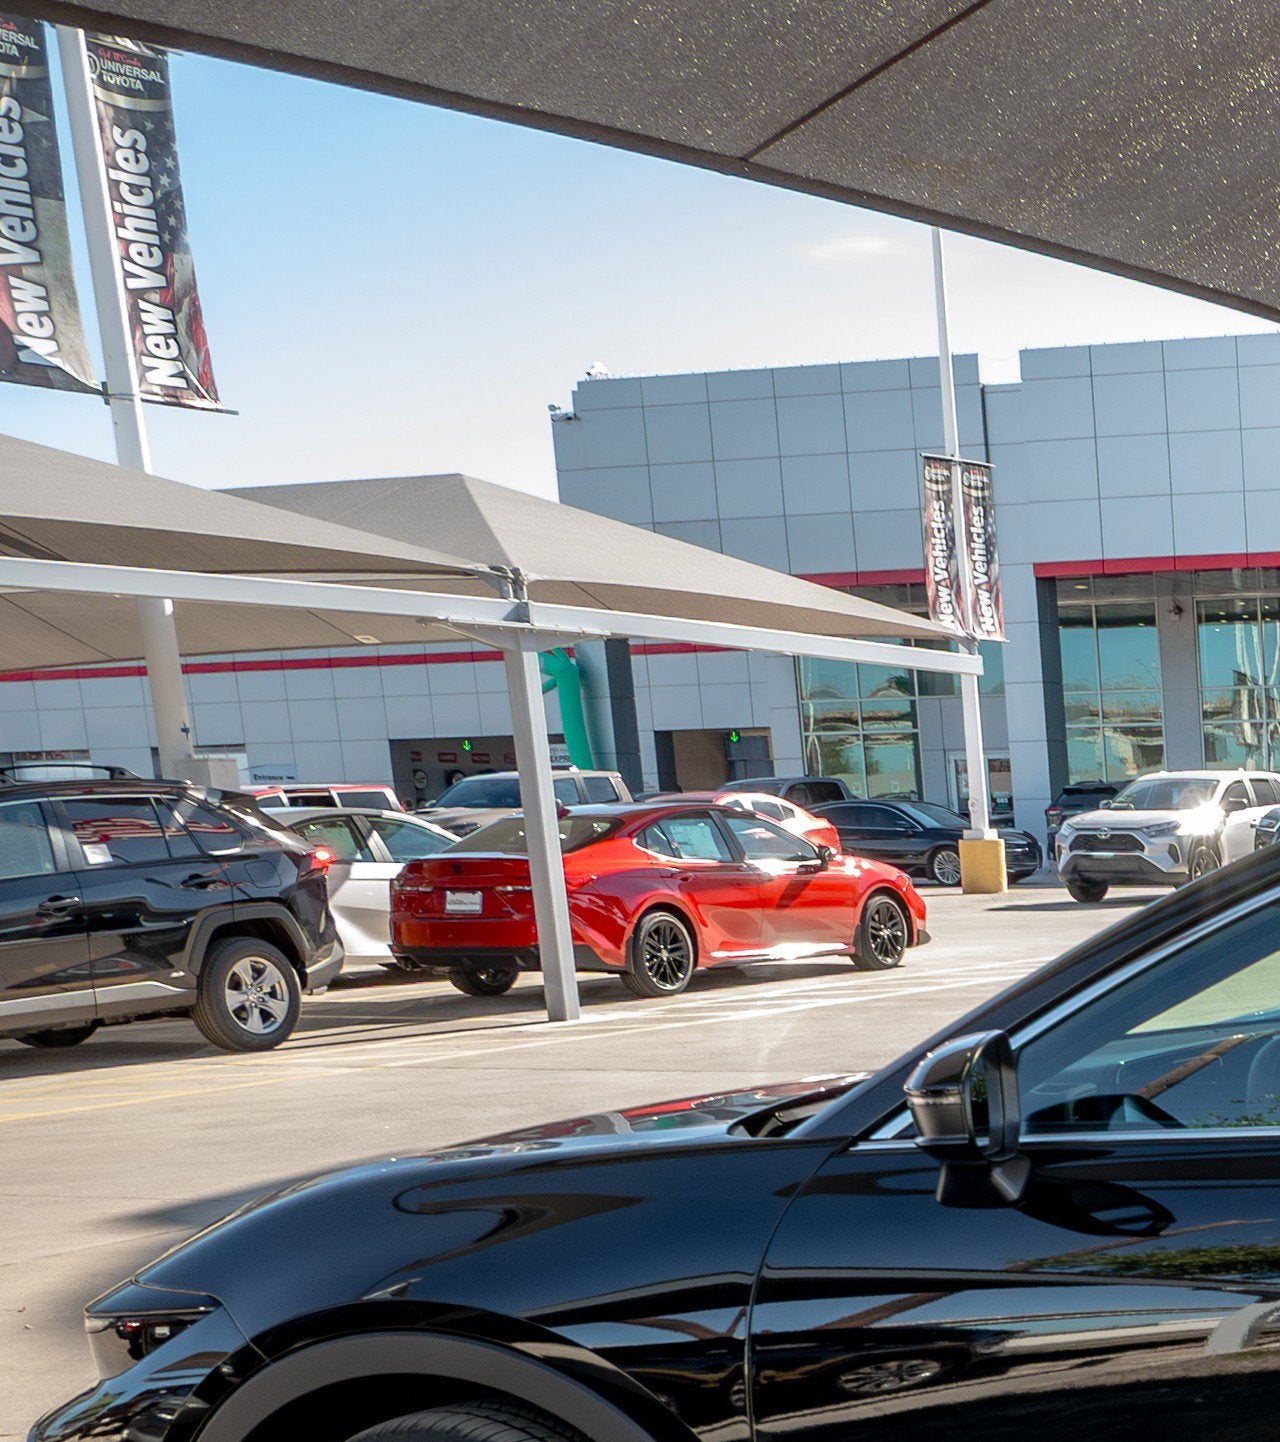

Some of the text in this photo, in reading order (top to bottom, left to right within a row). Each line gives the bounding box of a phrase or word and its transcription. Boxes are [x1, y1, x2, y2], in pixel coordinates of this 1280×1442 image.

[0, 28, 40, 50] ERSAL
[0, 41, 20, 57] OTA
[100, 57, 166, 84] UNIVERSAL
[100, 70, 145, 92] TOYOTA
[108, 125, 190, 390] New Vehicles
[8, 275, 60, 368] New
[930, 500, 949, 583] Vehicles
[970, 505, 990, 586] Vehicles
[938, 584, 959, 631] New
[978, 588, 997, 633] New
